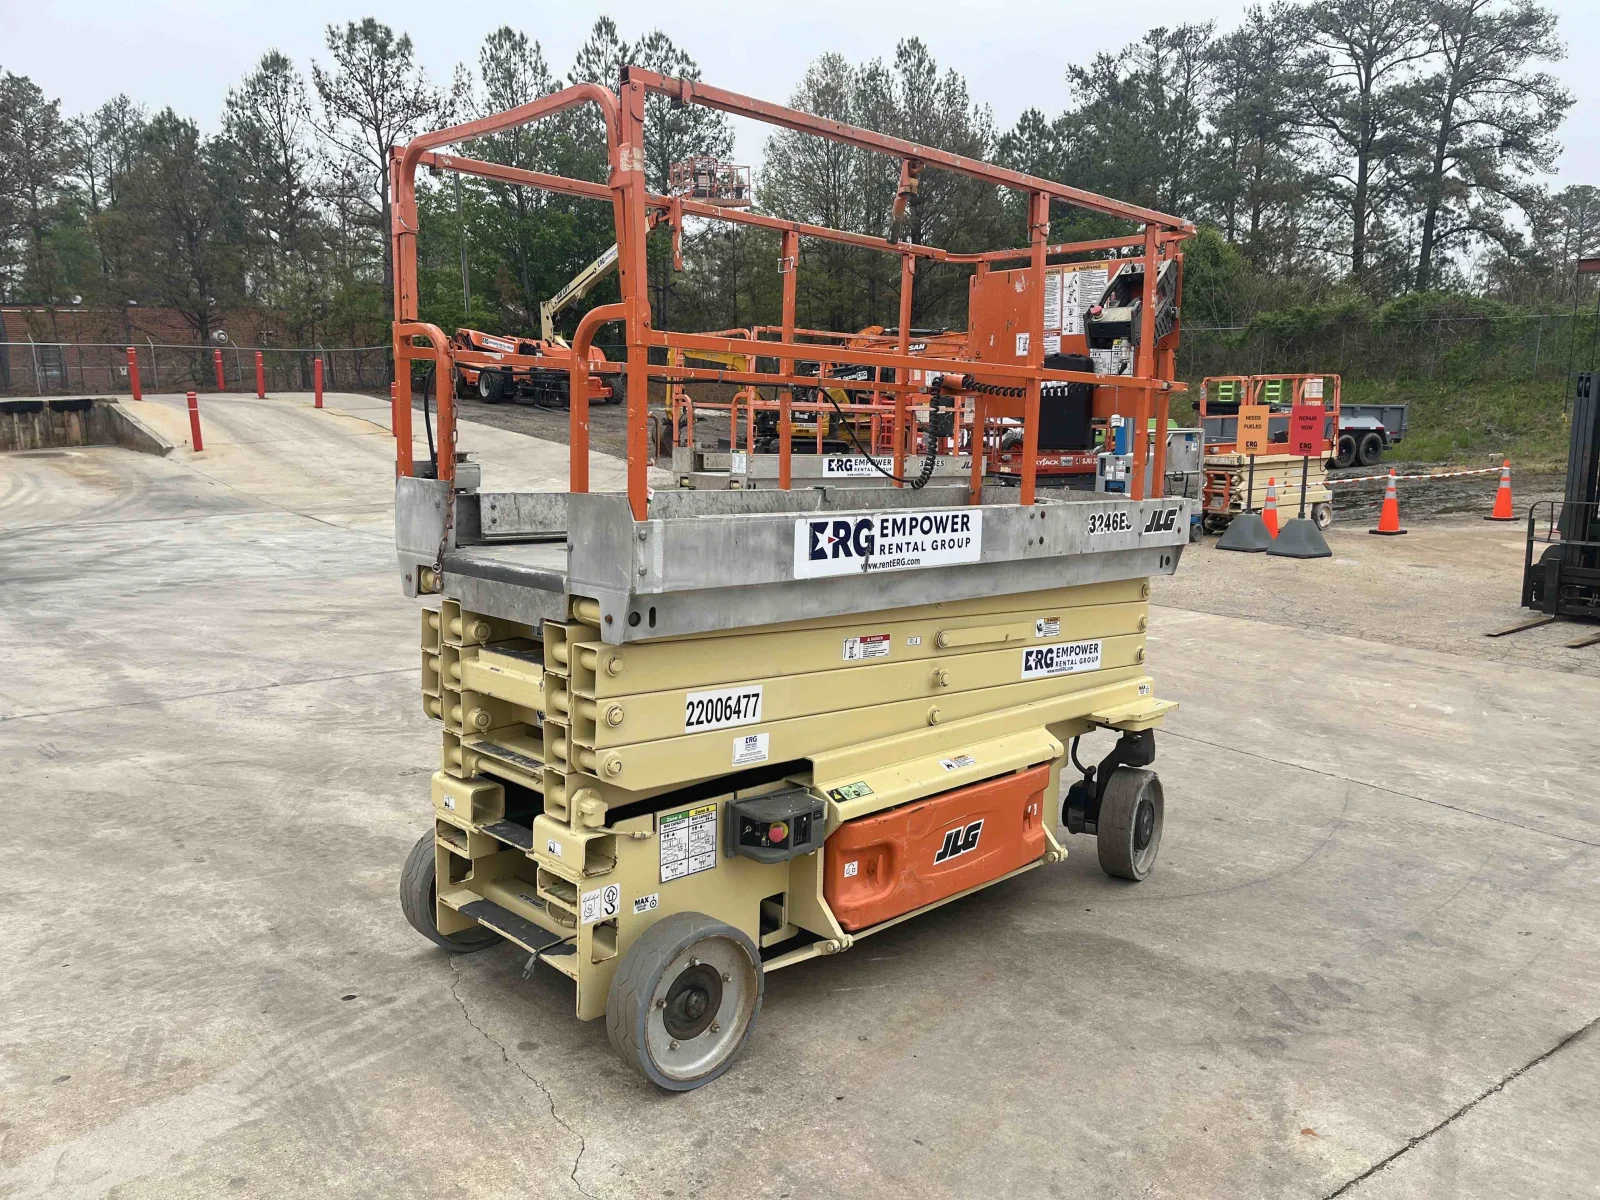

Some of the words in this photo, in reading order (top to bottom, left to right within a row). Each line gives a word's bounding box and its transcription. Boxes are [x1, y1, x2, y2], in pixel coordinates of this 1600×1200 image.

[827, 458, 853, 472] ERG
[880, 514, 971, 538] EMPOWER
[1143, 508, 1178, 533] JLG
[809, 518, 875, 561] ERG
[879, 541, 926, 555] RENTAL
[931, 537, 971, 551] GROUP
[861, 558, 921, 570] www.rentERG.com
[1024, 648, 1054, 671] ERG
[1056, 643, 1099, 658] EMPOWER
[1055, 659, 1077, 667] RENTAL
[1079, 656, 1099, 664] GROUP
[686, 693, 760, 727] 22006477
[745, 735, 758, 744] ERG
[934, 819, 984, 864] JLG
[634, 896, 649, 906] MAX
